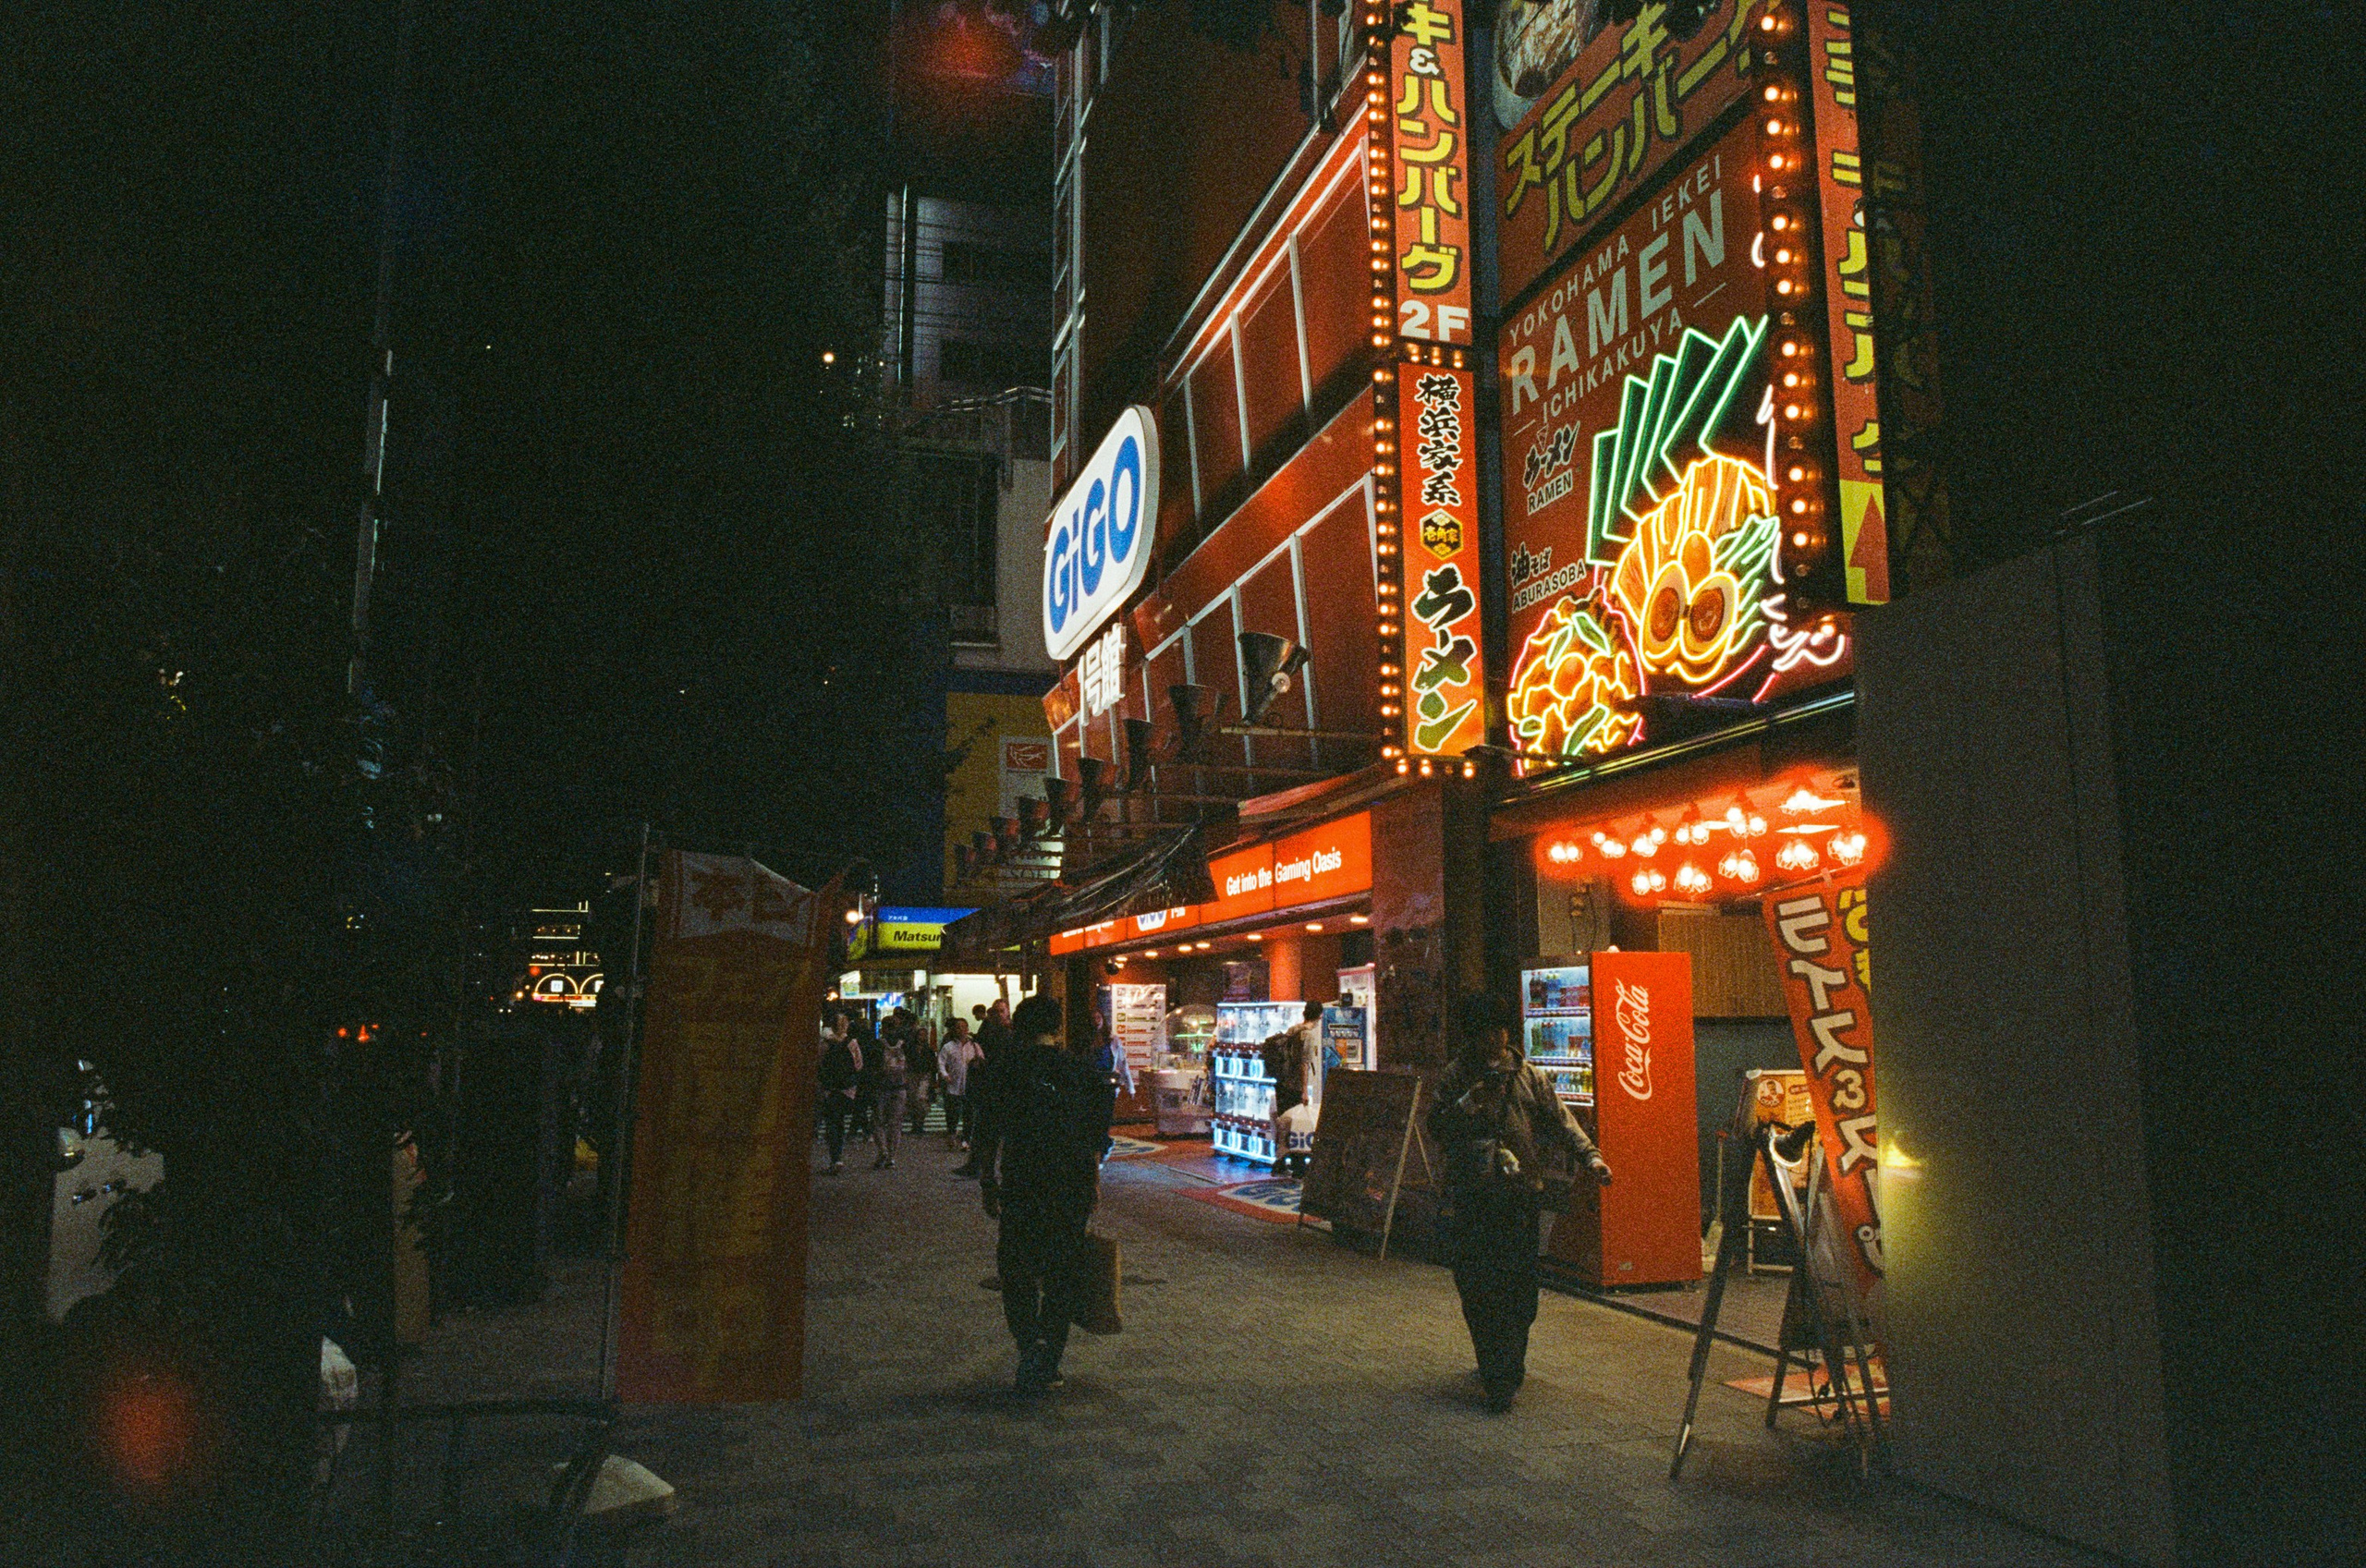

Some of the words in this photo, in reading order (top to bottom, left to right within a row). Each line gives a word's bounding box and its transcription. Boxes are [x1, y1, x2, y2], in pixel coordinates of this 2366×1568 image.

[1506, 0, 1666, 215] ステーキ
[1509, 234, 1629, 346] YOKOHAMA
[1653, 154, 1721, 232] IEKEI
[1510, 188, 1725, 416] RAMEN
[1399, 300, 1470, 342] 2F
[1543, 307, 1682, 423] ICHIKAKUYA
[1414, 372, 1462, 506] 横浜家系
[1523, 419, 1581, 492] ラーメン
[1527, 468, 1573, 516] RAMEN
[1049, 435, 1140, 635] GiGO
[1510, 541, 1552, 589] 油そば
[1512, 558, 1587, 614] ABURASOBA
[1410, 563, 1478, 753] ラーメン
[1226, 876, 1240, 896] Get
[1241, 872, 1257, 892] into
[1258, 867, 1273, 888] the
[1275, 857, 1311, 882] Gaming
[1312, 846, 1342, 874] Oasis
[1616, 978, 1653, 1100] Coca-Cola
